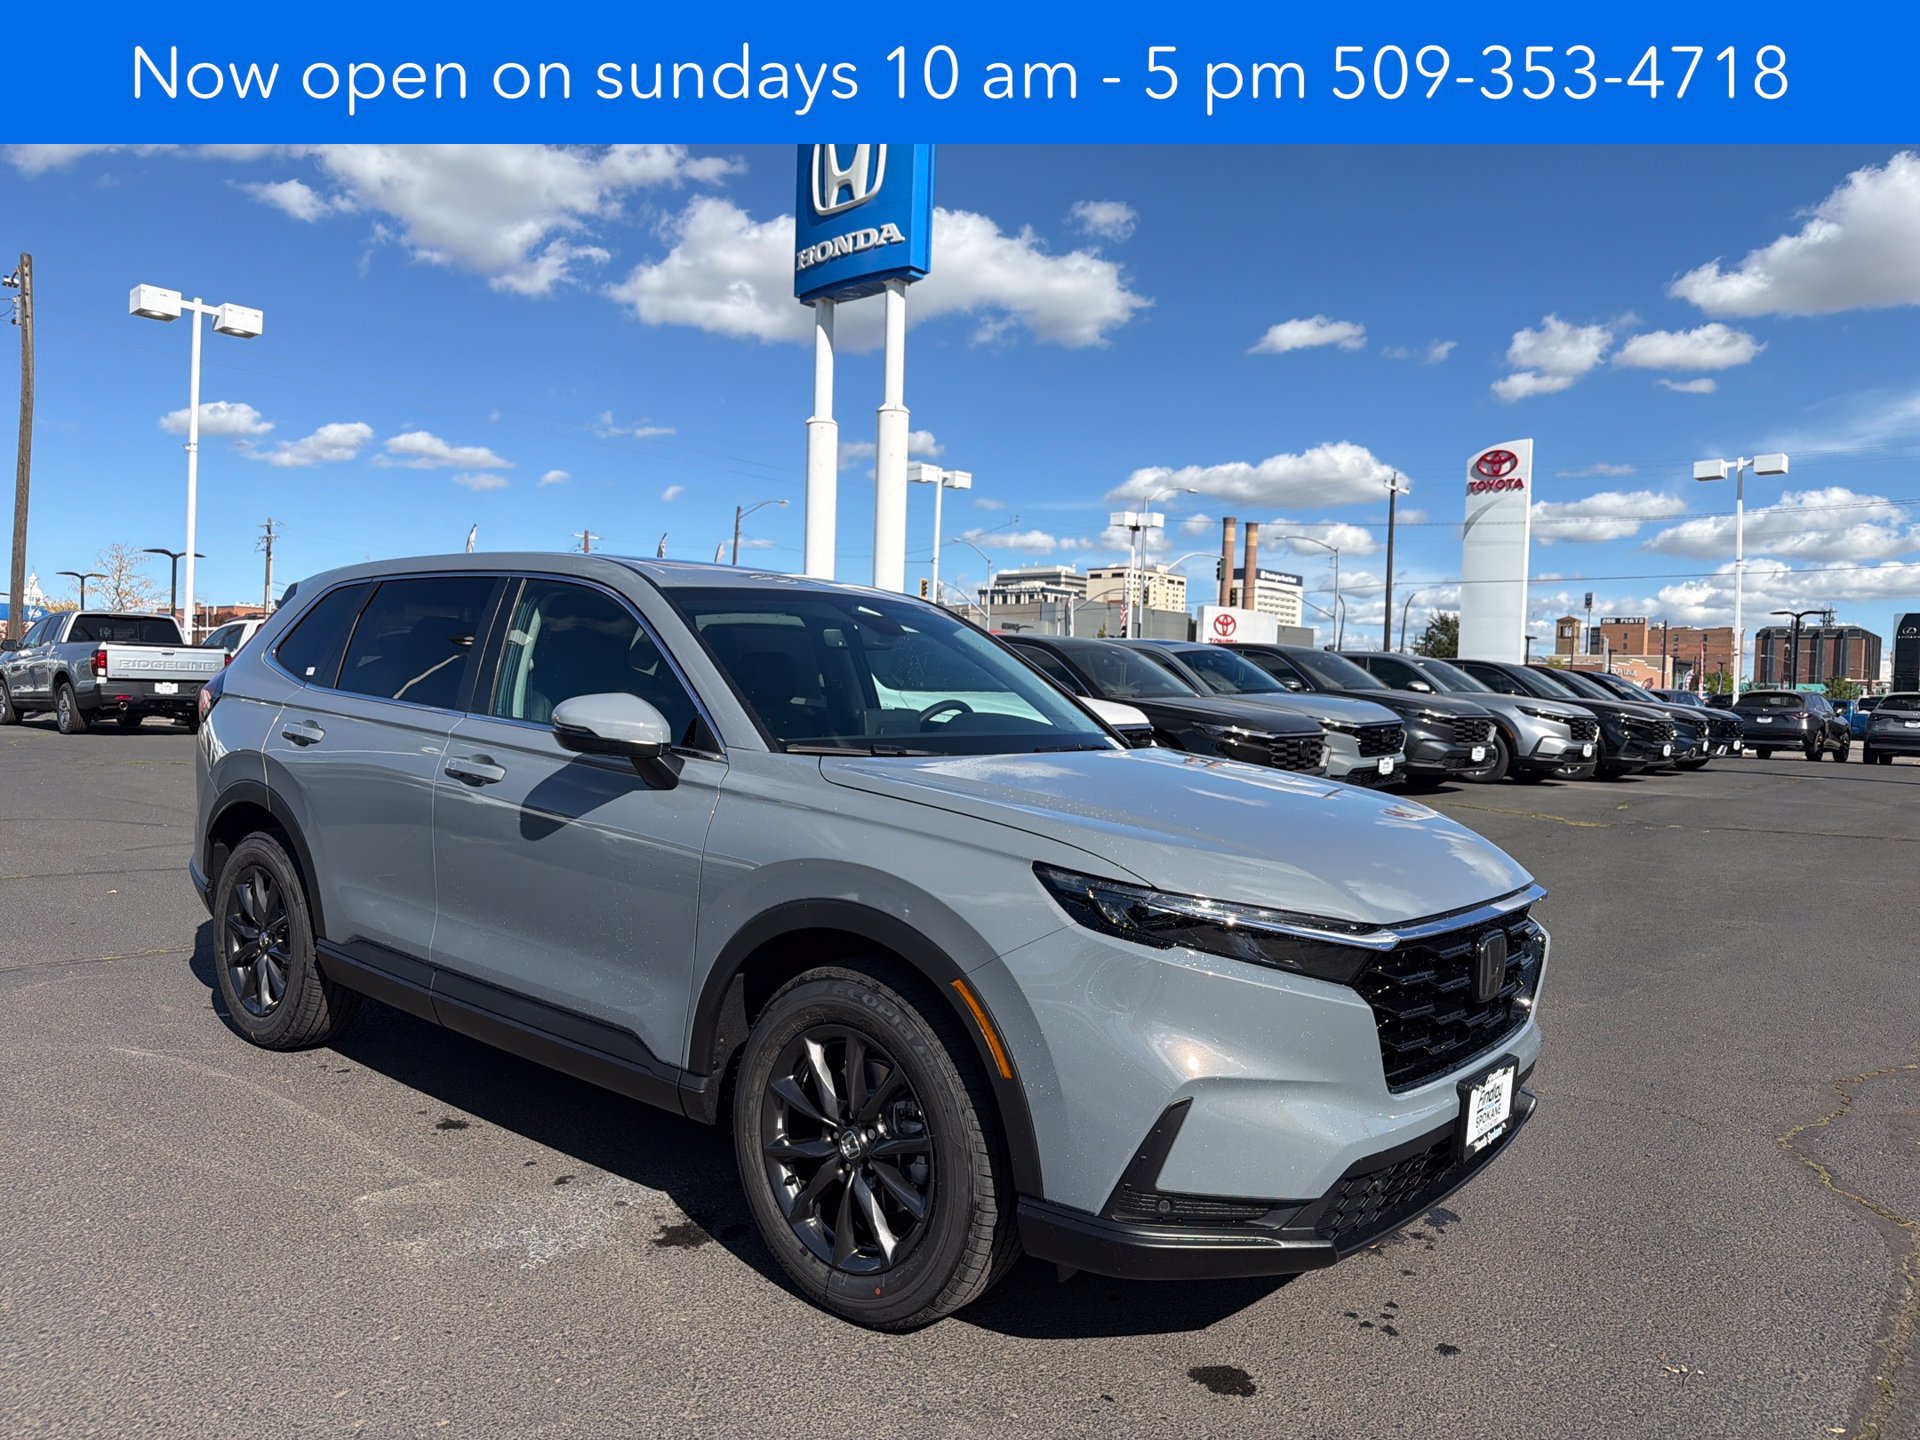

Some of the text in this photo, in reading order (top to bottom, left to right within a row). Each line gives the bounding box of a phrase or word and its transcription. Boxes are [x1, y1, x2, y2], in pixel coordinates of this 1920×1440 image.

[796, 223, 905, 271] HONDA
[1467, 478, 1524, 493] TOYOTA
[119, 659, 219, 671] RIDGELINE
[1475, 1103, 1502, 1129] SPOKANE
